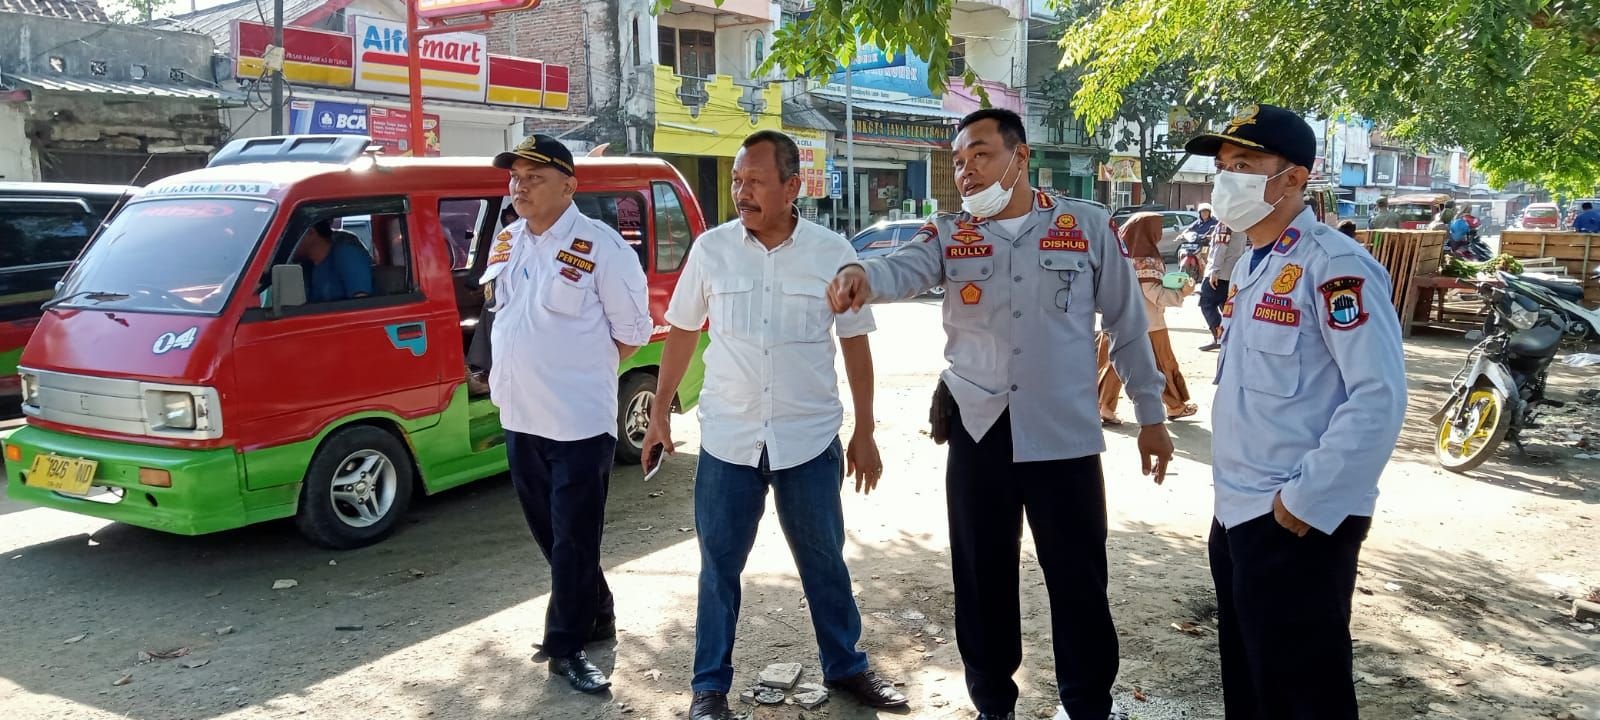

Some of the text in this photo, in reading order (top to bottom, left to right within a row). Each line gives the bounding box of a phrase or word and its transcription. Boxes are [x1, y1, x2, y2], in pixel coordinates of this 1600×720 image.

[336, 114, 367, 130] BCA
[832, 173, 840, 188] P
[951, 247, 988, 256] RULLY
[1042, 240, 1086, 250] DISHUB
[558, 252, 594, 272] PENYIDIK
[1255, 307, 1295, 323] DISHUB
[152, 326, 198, 354] 04
[76, 463, 93, 484] ND
